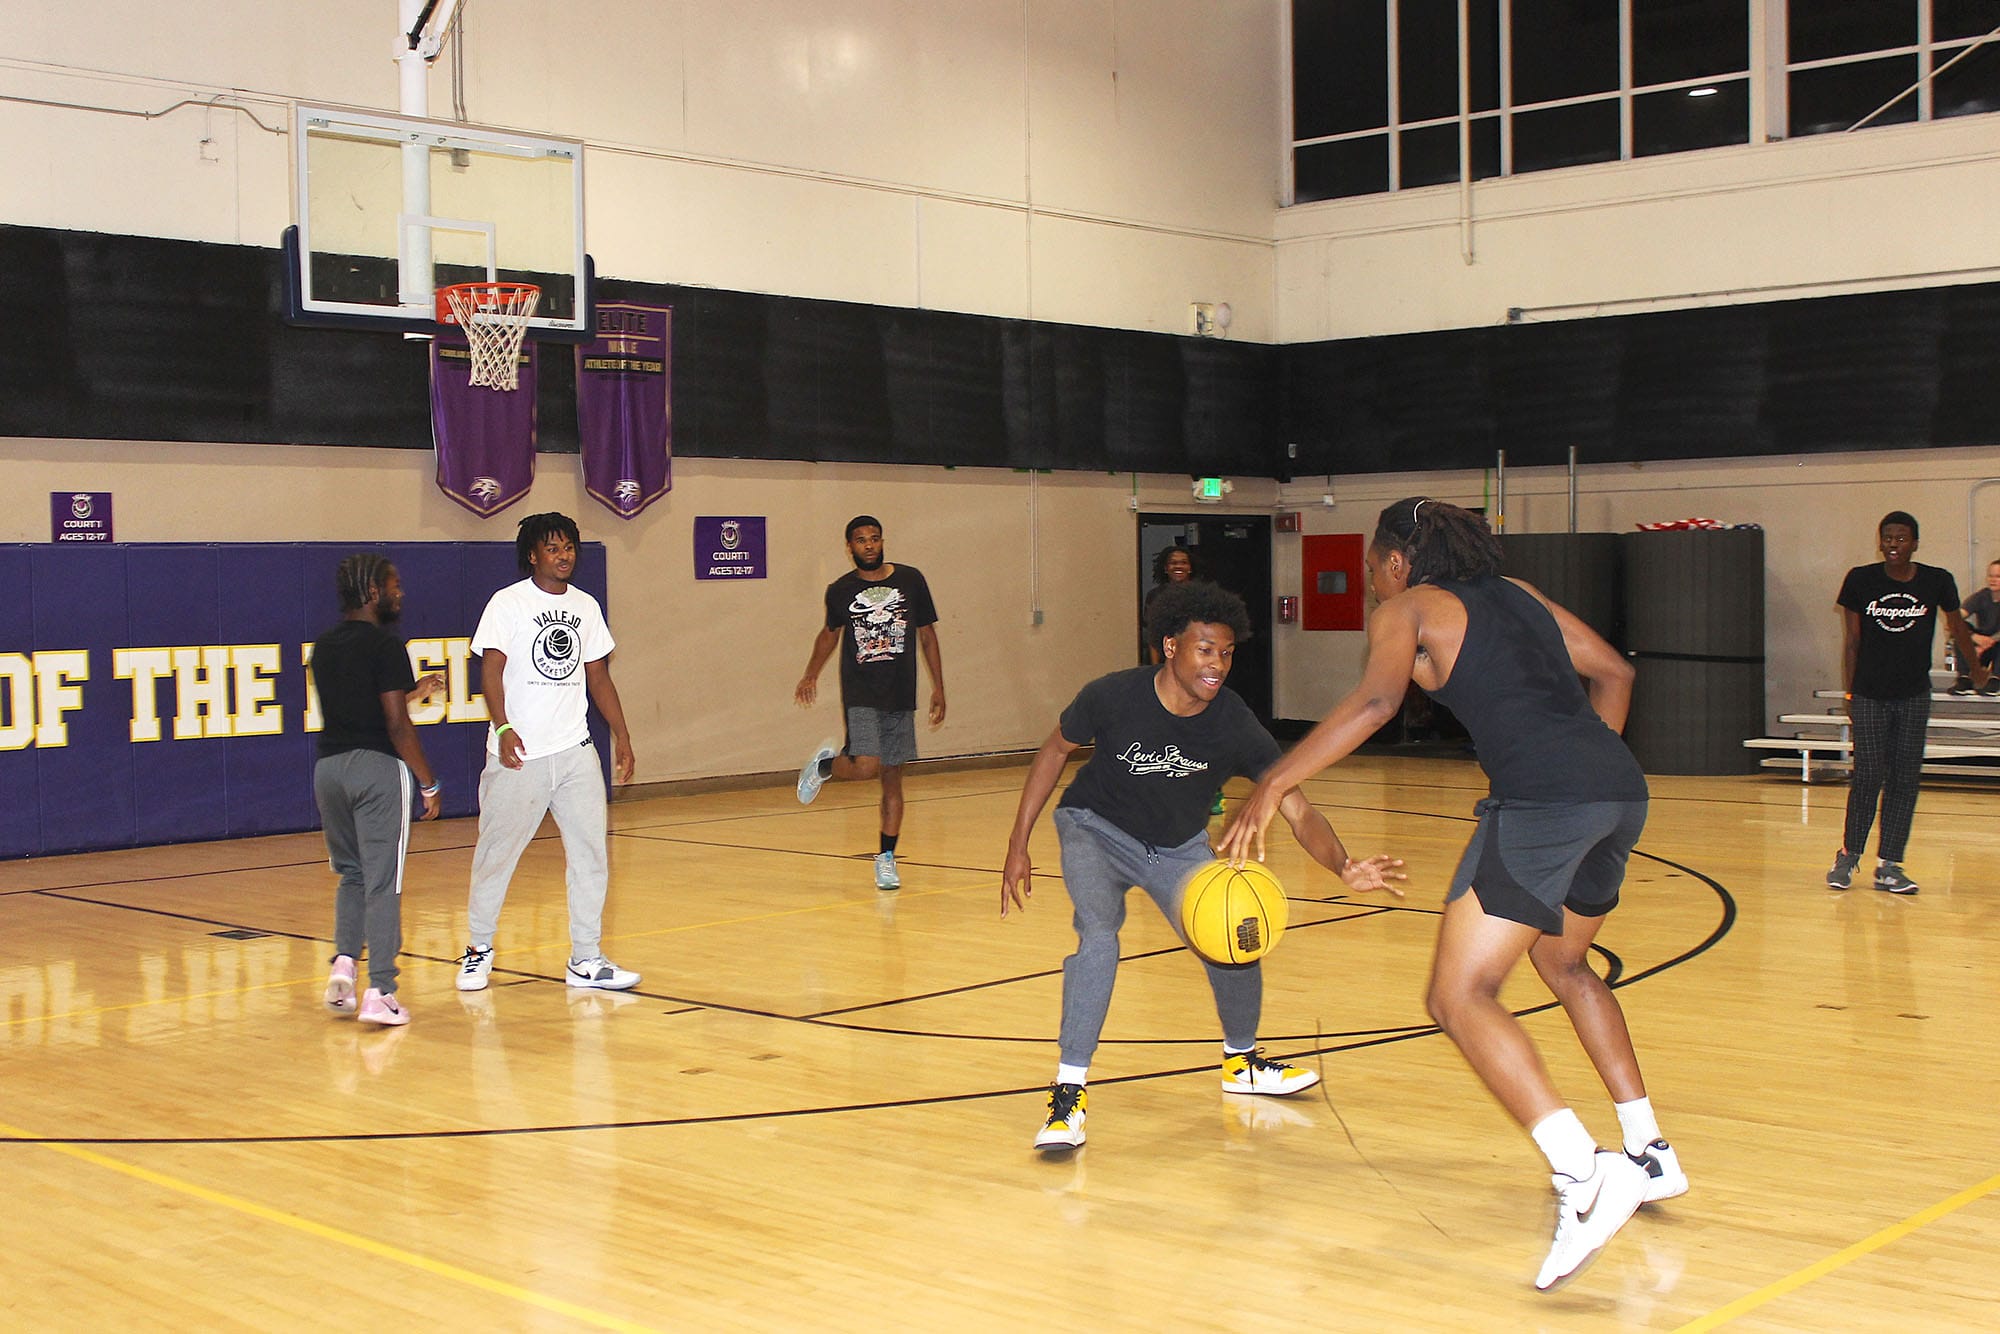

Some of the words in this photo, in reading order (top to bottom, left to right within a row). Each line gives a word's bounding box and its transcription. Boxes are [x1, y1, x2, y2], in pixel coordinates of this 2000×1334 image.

[597, 311, 646, 333] ELITE
[607, 340, 638, 354] MALE
[63, 520, 95, 528] COURT
[59, 533, 85, 541] AGES
[86, 533, 107, 541] 12-17
[712, 551, 741, 561] COURT
[708, 566, 732, 576] AGES
[733, 566, 754, 576] 12-17
[533, 609, 582, 629] VALLEJO
[1866, 601, 1928, 620] Aeropostale
[537, 656, 577, 677] BASKETBALL
[0, 649, 90, 750] OF
[112, 644, 283, 742] THE
[1116, 741, 1157, 764] Levi
[1156, 744, 1208, 769] Strauss
